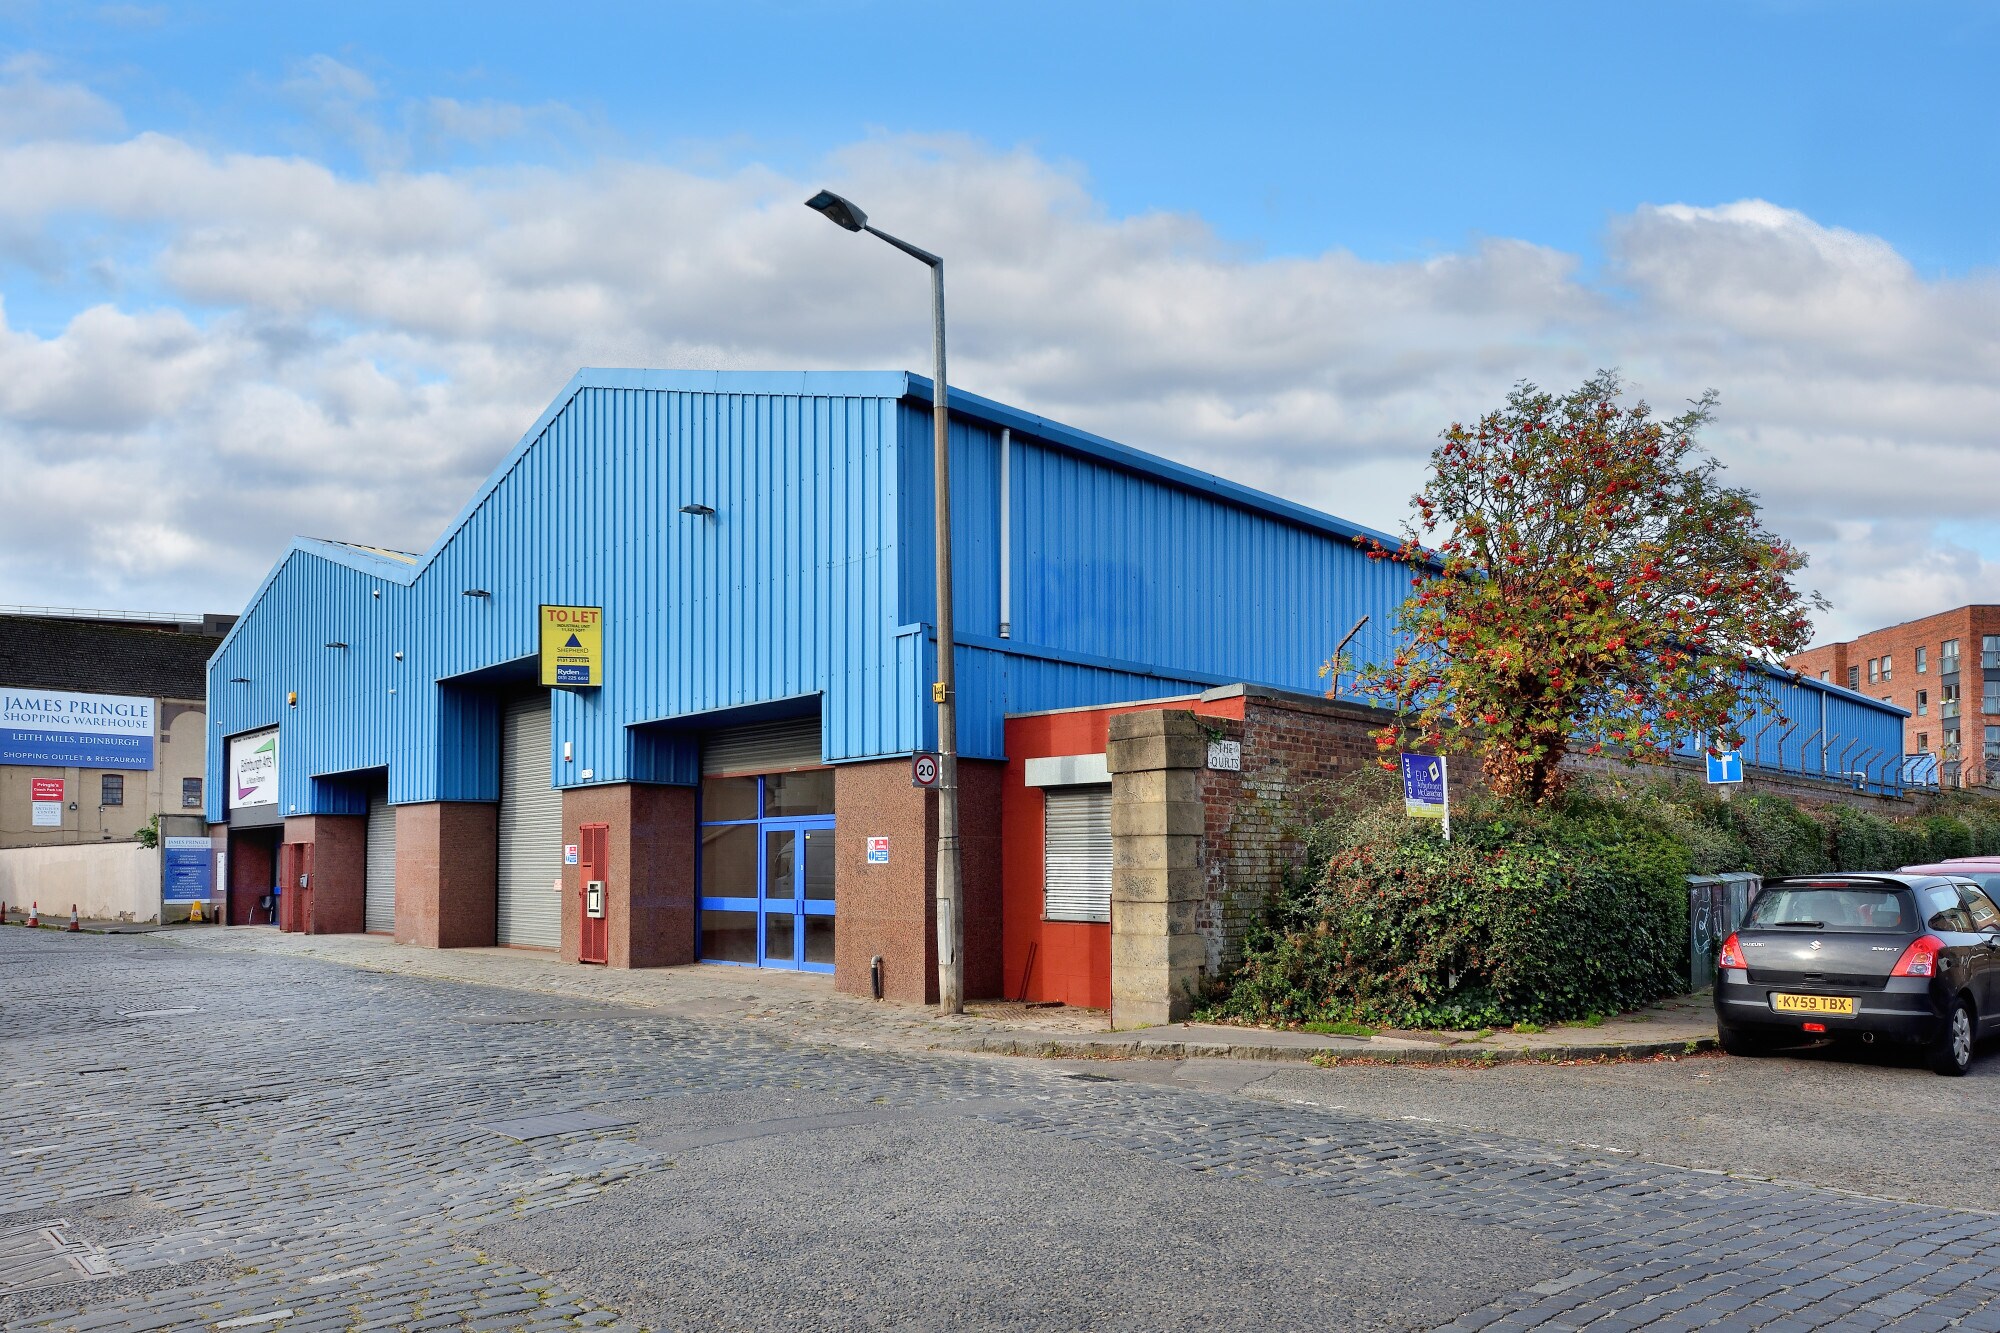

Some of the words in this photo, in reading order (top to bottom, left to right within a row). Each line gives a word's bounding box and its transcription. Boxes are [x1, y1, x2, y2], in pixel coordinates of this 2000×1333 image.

[547, 609, 568, 622] TO
[572, 610, 598, 623] LET
[557, 668, 580, 676] Ryden
[4, 696, 62, 712] JAMES
[69, 700, 148, 718] PRINGLE
[3, 712, 70, 724] SHOPPING
[74, 716, 148, 729] WAREHOUSE
[13, 732, 42, 742] LEITH
[45, 734, 77, 744] MILLS,
[79, 736, 139, 746] EDINBURGH
[1219, 742, 1233, 754] THE
[3, 751, 49, 760] SHOPPING
[51, 753, 83, 761] OUTLET
[95, 756, 147, 764] RESTAURANT
[240, 755, 262, 774] Edinburgh
[262, 754, 272, 768] Arts
[918, 764, 934, 777] 20
[1416, 770, 1428, 782] ELP
[1783, 995, 1817, 1009] KY59
[1821, 998, 1847, 1010] TBX
